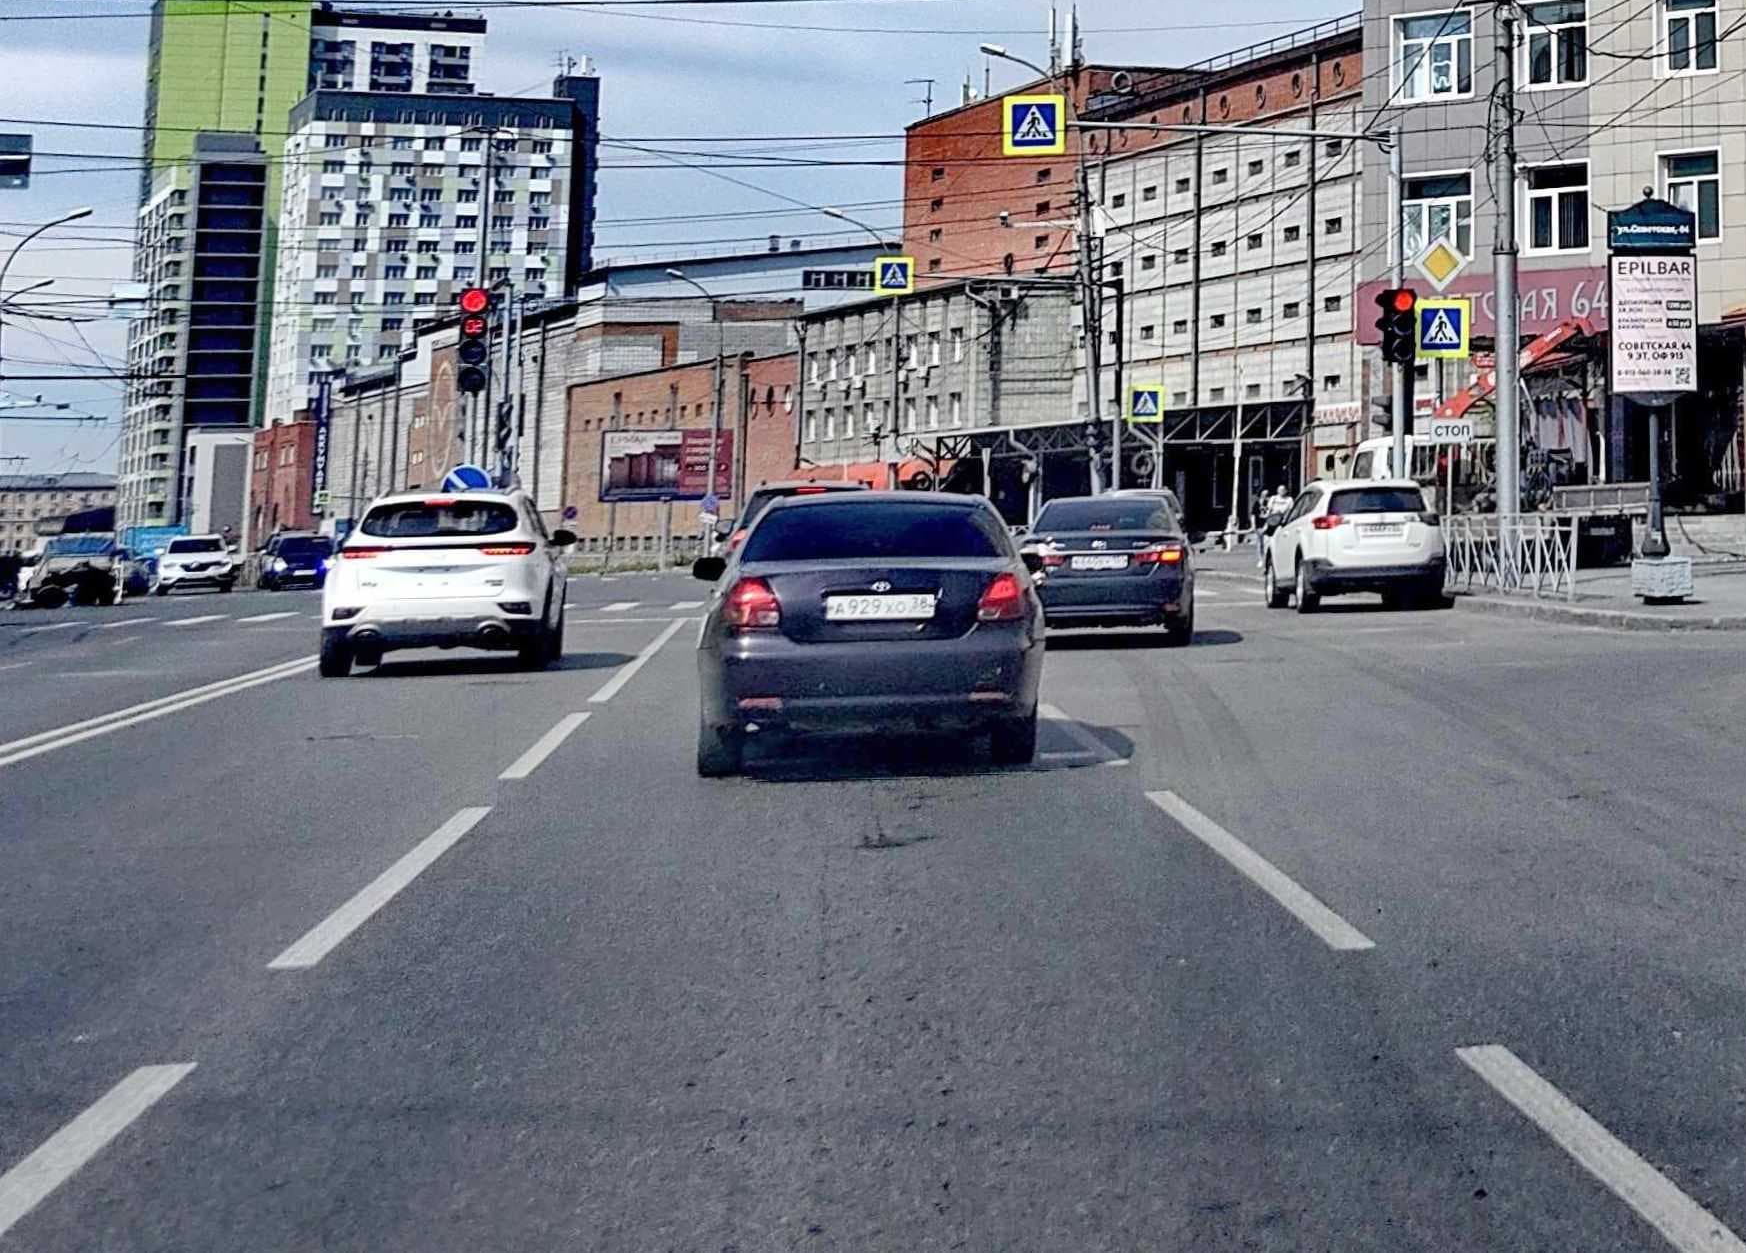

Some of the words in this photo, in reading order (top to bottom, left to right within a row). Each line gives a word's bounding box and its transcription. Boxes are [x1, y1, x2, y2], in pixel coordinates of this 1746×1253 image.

[1618, 261, 1691, 275] EPILBAR
[1571, 281, 1609, 320] 64
[1434, 424, 1471, 437] СТОП
